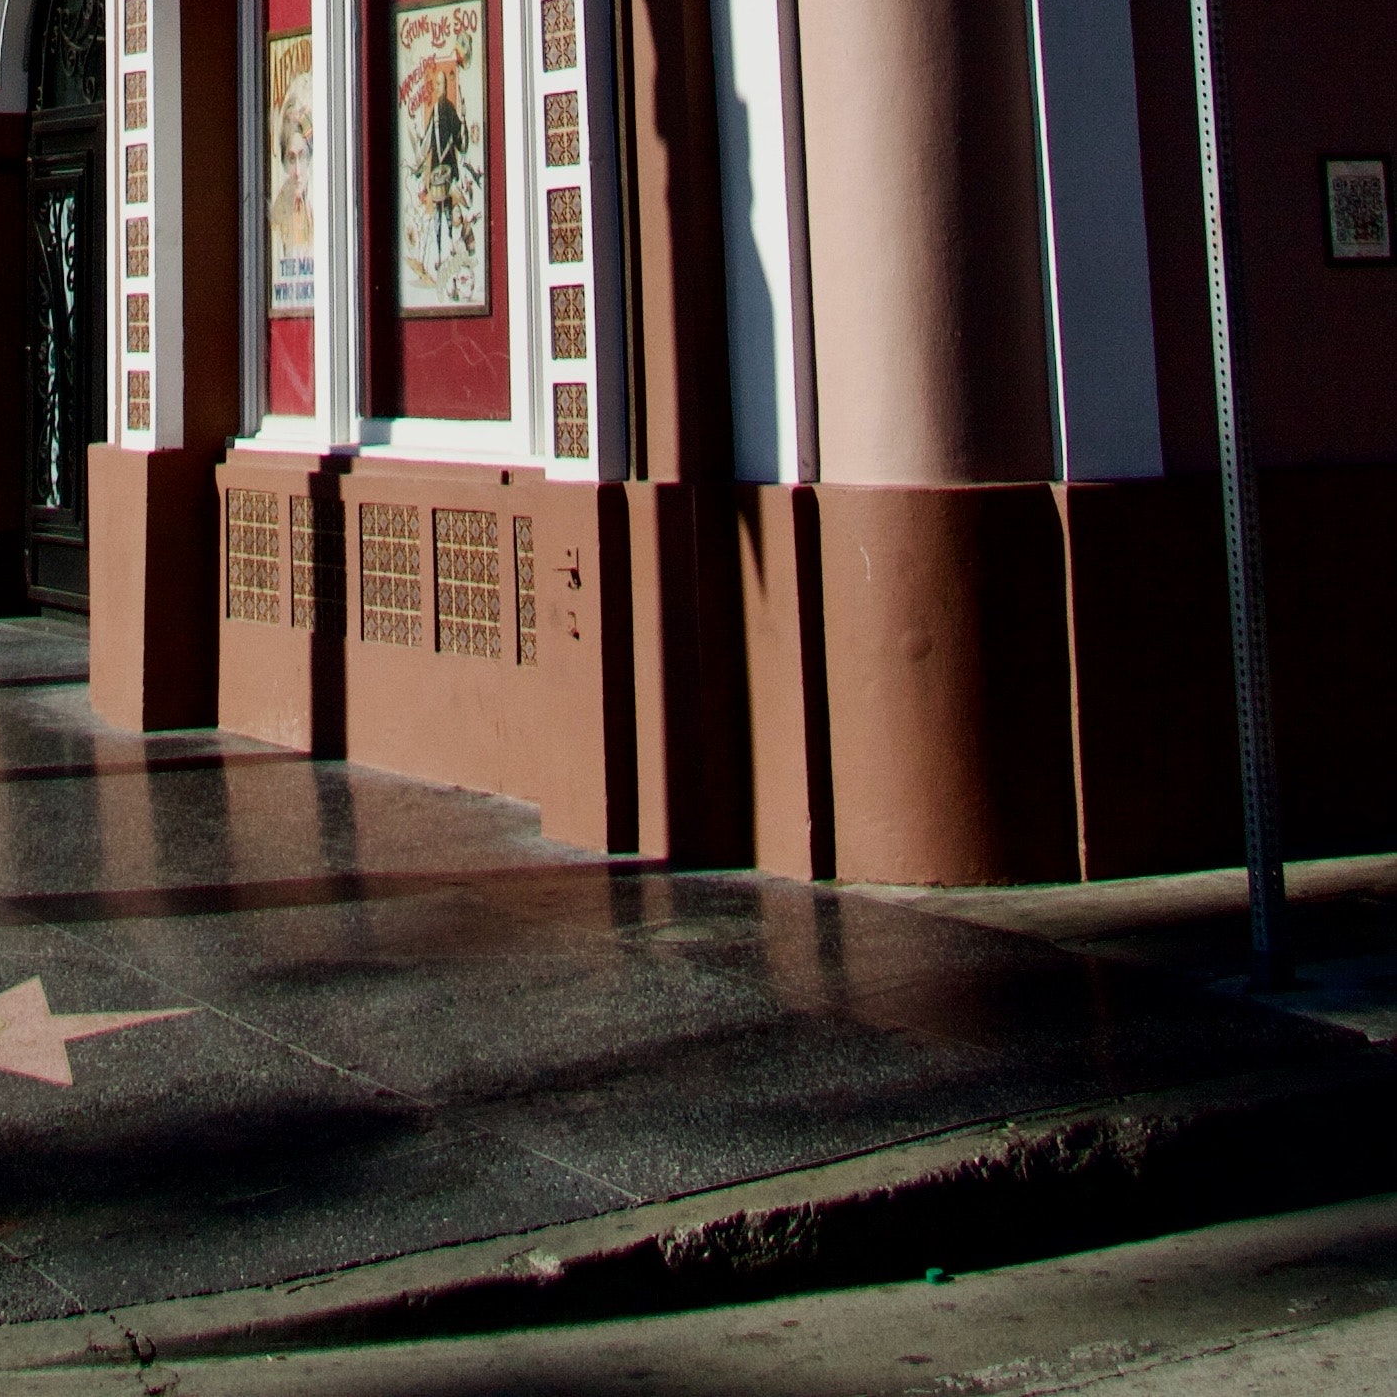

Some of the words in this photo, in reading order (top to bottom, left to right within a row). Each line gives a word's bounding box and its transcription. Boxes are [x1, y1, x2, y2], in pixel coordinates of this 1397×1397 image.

[400, 14, 430, 50] CHUNG
[453, 7, 478, 35] SOO
[280, 258, 296, 277] THE
